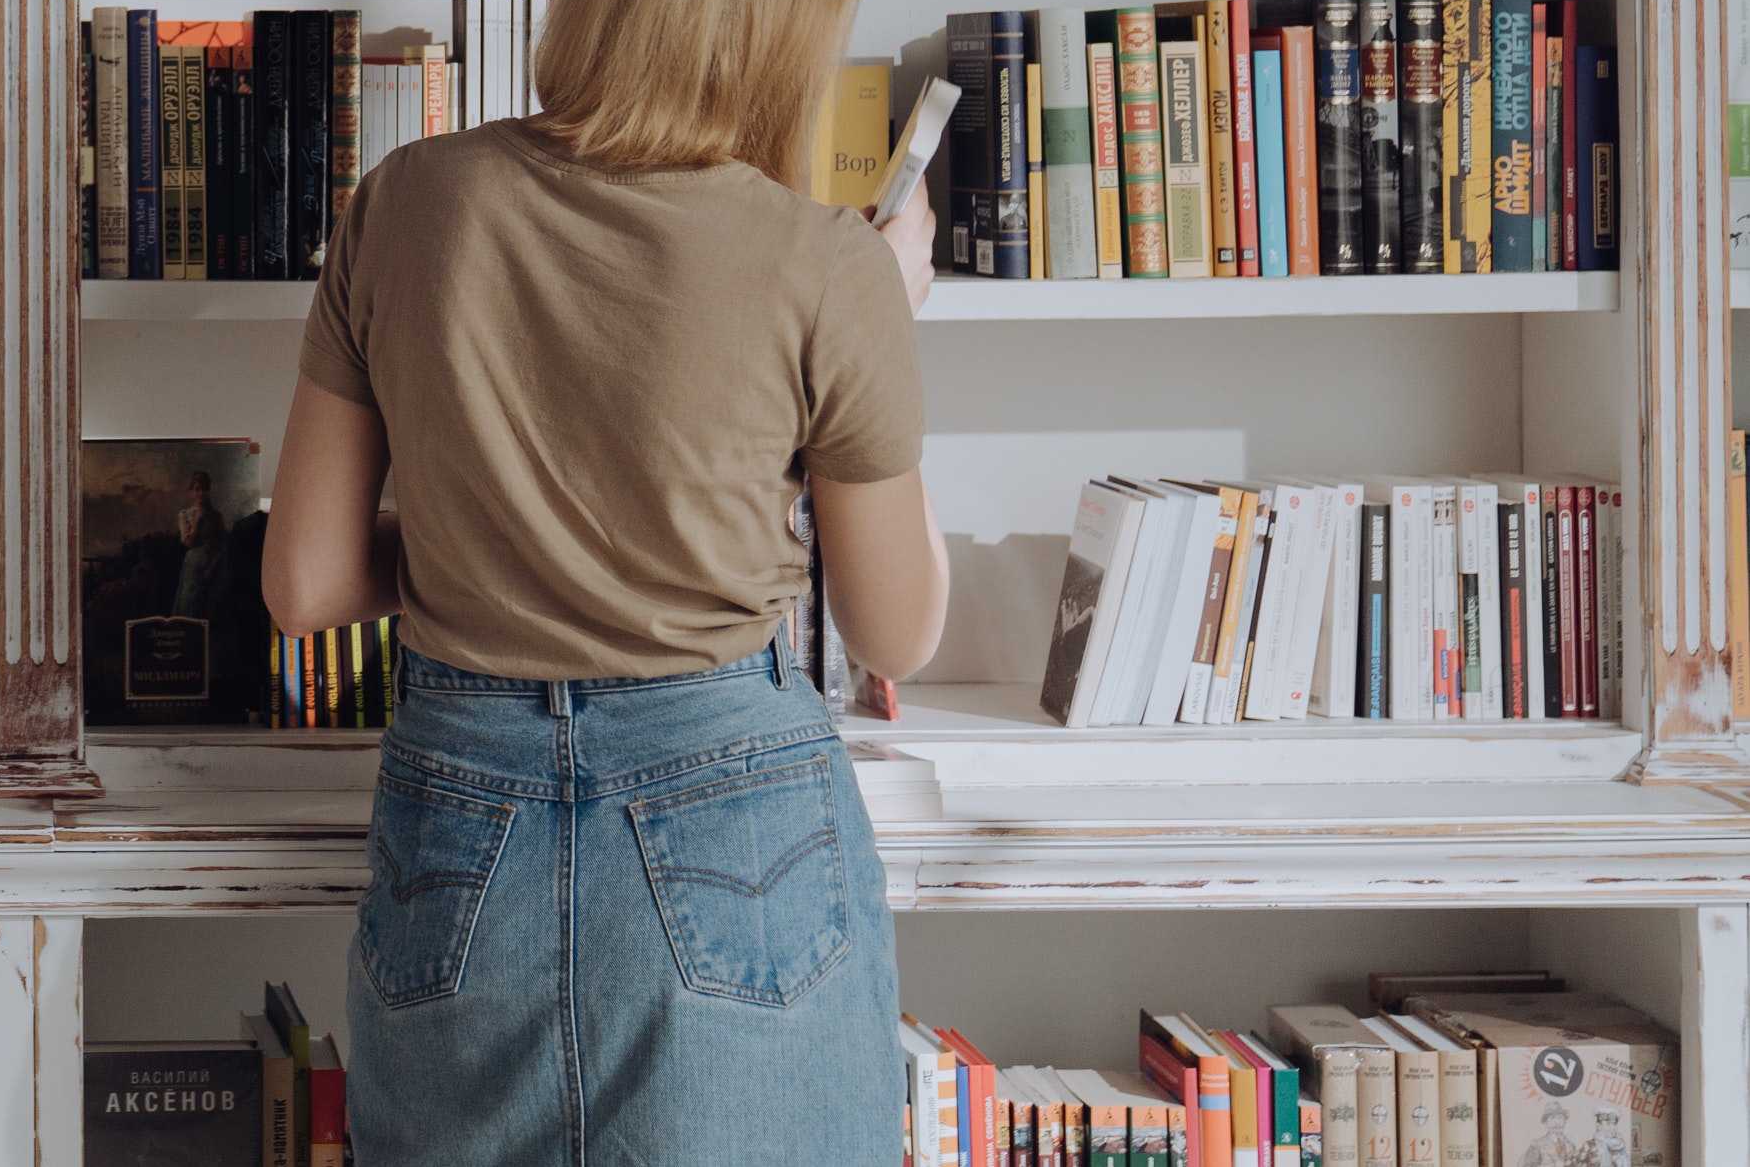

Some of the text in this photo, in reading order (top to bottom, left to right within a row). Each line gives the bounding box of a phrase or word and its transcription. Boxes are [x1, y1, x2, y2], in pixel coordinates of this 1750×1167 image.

[1494, 12, 1531, 130] НИЧЕЙНОГО ОТЦА ДЕТИ
[163, 65, 179, 165] ДЖОРДЖ ОРУЭЛЛ
[1096, 62, 1115, 164] ОЛДОС ХАКСЛИ
[1173, 58, 1194, 163] ДЖОЗЕФ ХЕЛЛЕР
[1212, 90, 1229, 134] ИЗГОИ
[834, 153, 877, 176] Вор
[1494, 139, 1531, 215] АРНО ШМИДТ
[165, 206, 181, 257] 1984
[1190, 671, 1204, 715] LAROUSSE
[1226, 672, 1239, 714] LAROUSSE
[130, 1069, 210, 1084] ВАСИЛИЙ
[1538, 1052, 1668, 1119] 12 СТУЛЬЕВ
[106, 1088, 235, 1113] АКСЁНОВ
[1368, 1135, 1392, 1160] 12
[1409, 1138, 1433, 1161] 12
